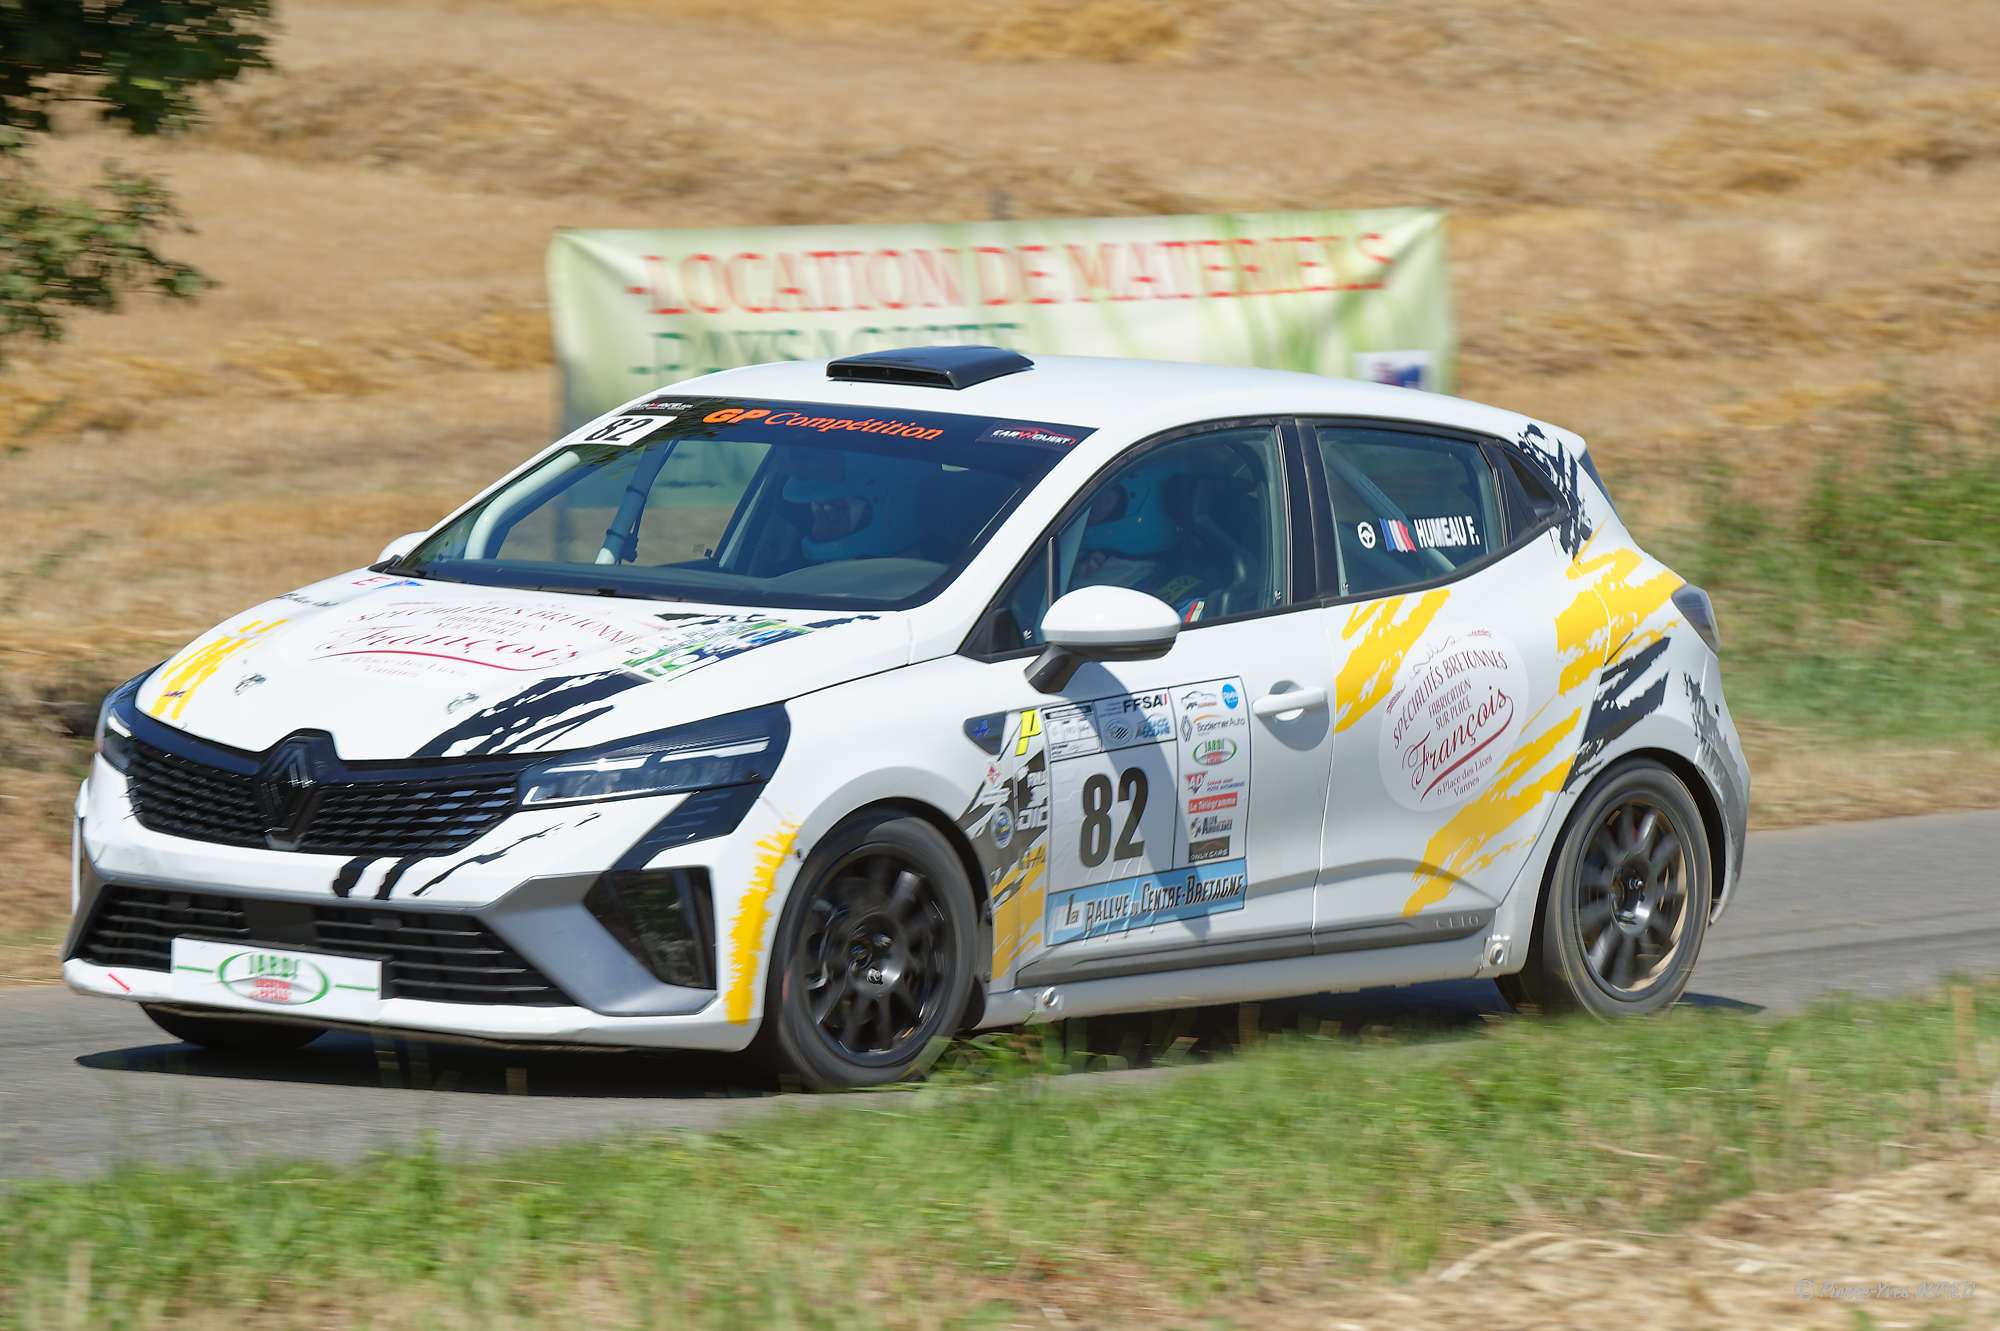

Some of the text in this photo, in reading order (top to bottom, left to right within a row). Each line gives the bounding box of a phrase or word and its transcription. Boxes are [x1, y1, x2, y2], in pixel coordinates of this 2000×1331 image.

[640, 248, 965, 316] LOCATION
[971, 245, 1058, 306] DE
[584, 418, 654, 441] 82
[702, 408, 944, 440] GP Compétition
[1413, 515, 1480, 548] HUMEAU F.
[1122, 693, 1163, 713] FFSA
[1393, 649, 1508, 750] SPÉCIALITÉS BRETONNES
[1428, 679, 1472, 719] FABRICATION
[1435, 695, 1471, 731] SUR PLACE
[1402, 686, 1510, 790] François
[1442, 775, 1461, 793] Place
[1461, 768, 1474, 780] des
[1453, 777, 1480, 797] Vannes
[1079, 767, 1148, 868] 82
[1085, 894, 1131, 934] RALLYE
[1140, 872, 1245, 914] CENTRE-BRETAGNE
